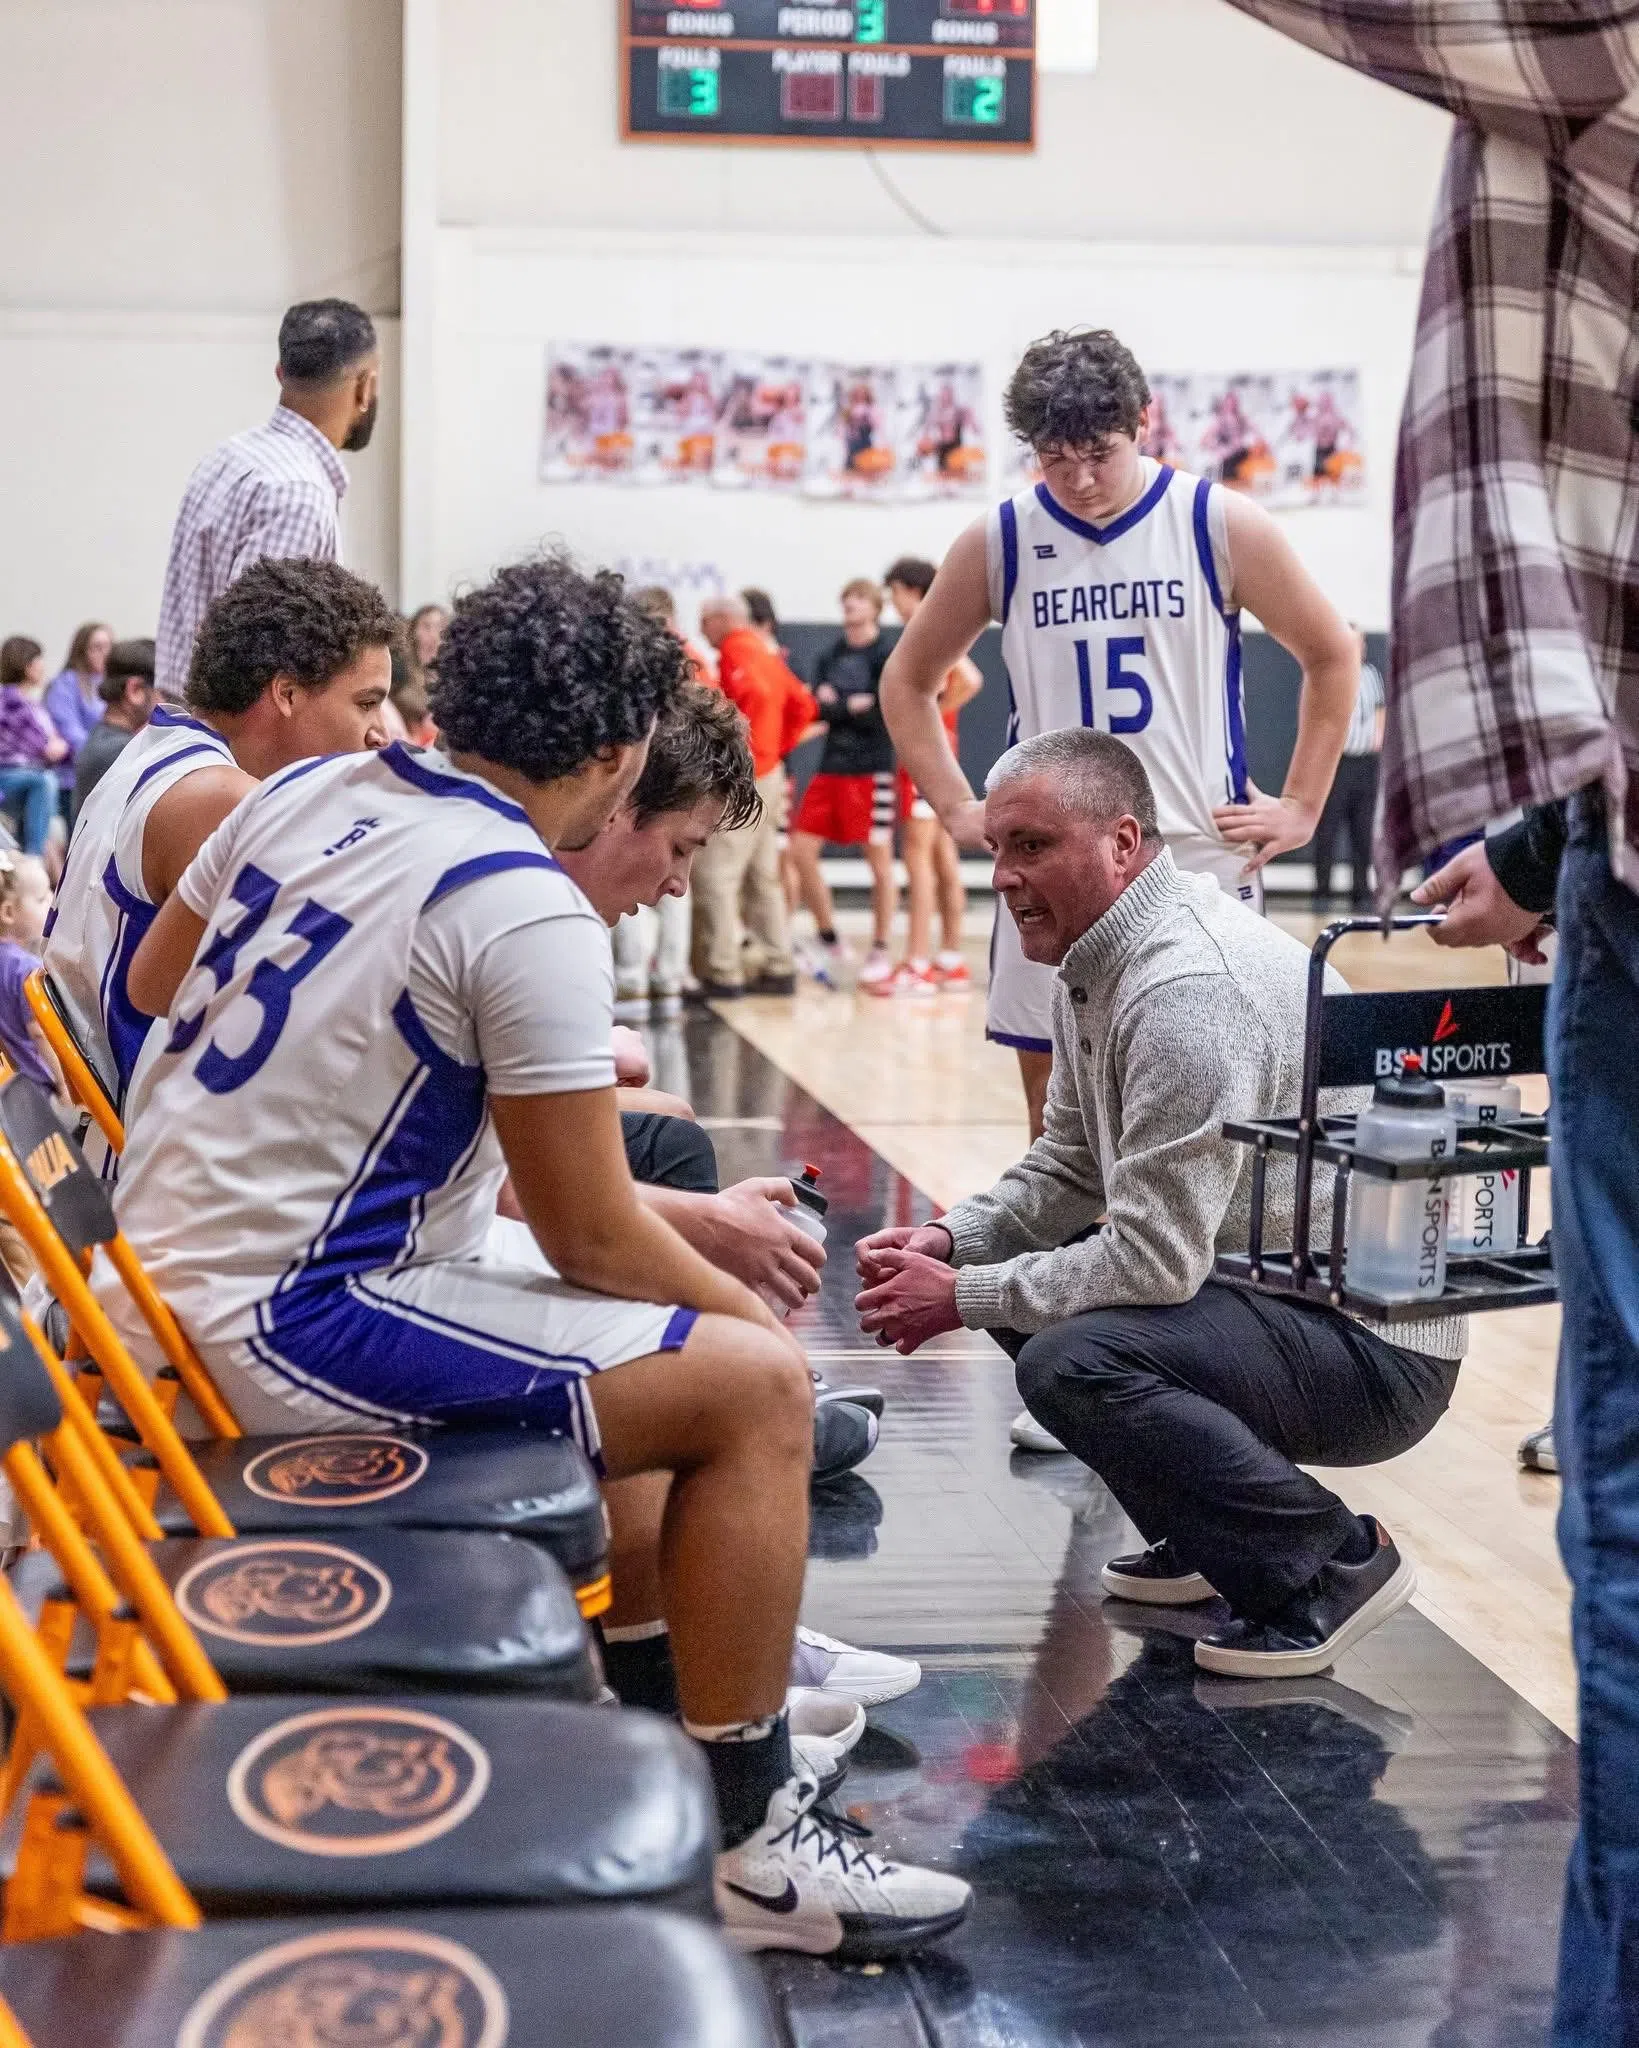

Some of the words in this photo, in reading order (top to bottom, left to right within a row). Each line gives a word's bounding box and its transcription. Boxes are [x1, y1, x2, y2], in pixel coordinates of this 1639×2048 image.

[778, 8, 853, 36] PERIOD
[689, 69, 718, 115] 3
[972, 77, 1003, 123] 2
[1033, 580, 1184, 628] BEARCATS
[1074, 636, 1153, 734] 15
[164, 862, 354, 1095] 33
[1473, 1175, 1495, 1249] PORTS
